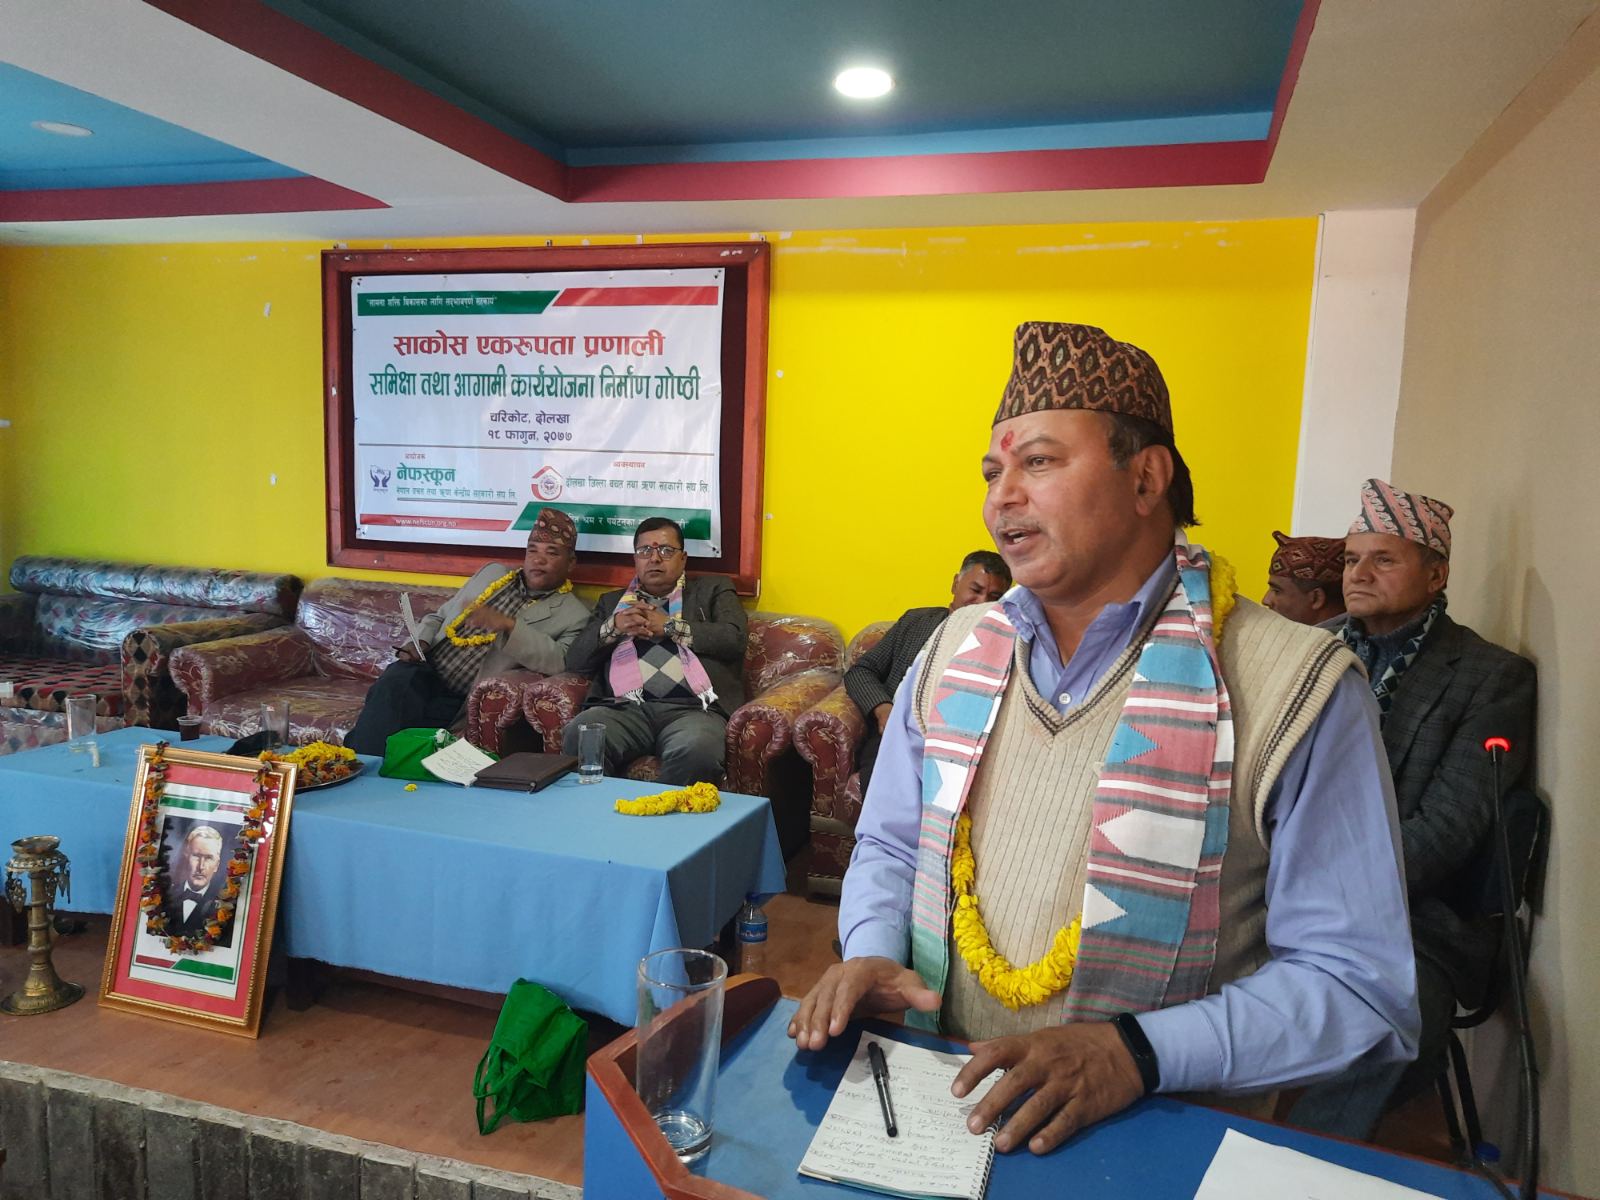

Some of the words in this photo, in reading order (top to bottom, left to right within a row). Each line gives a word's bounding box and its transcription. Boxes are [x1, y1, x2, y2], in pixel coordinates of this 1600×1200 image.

[393, 330, 469, 356] साकोस
[476, 335, 576, 356] एकरूपता
[584, 329, 666, 358] प्रणाली
[369, 363, 417, 397] समिक्षा
[420, 371, 451, 397] तथा
[454, 363, 508, 398] आगामी
[511, 364, 596, 399] कार्ययोजना
[599, 364, 651, 400] निर्माण
[654, 365, 701, 400] गोष्ठी
[490, 409, 531, 424] चरिकोट,
[535, 410, 571, 425] दोलखा
[488, 430, 501, 440] १८
[505, 430, 539, 445] फागुन,
[543, 431, 573, 443] २०७७
[566, 476, 585, 489] दोलखा
[588, 476, 607, 489] जिल्ला
[626, 480, 639, 491] तथा
[641, 480, 656, 492] ऋण
[659, 480, 683, 493] सहकारी
